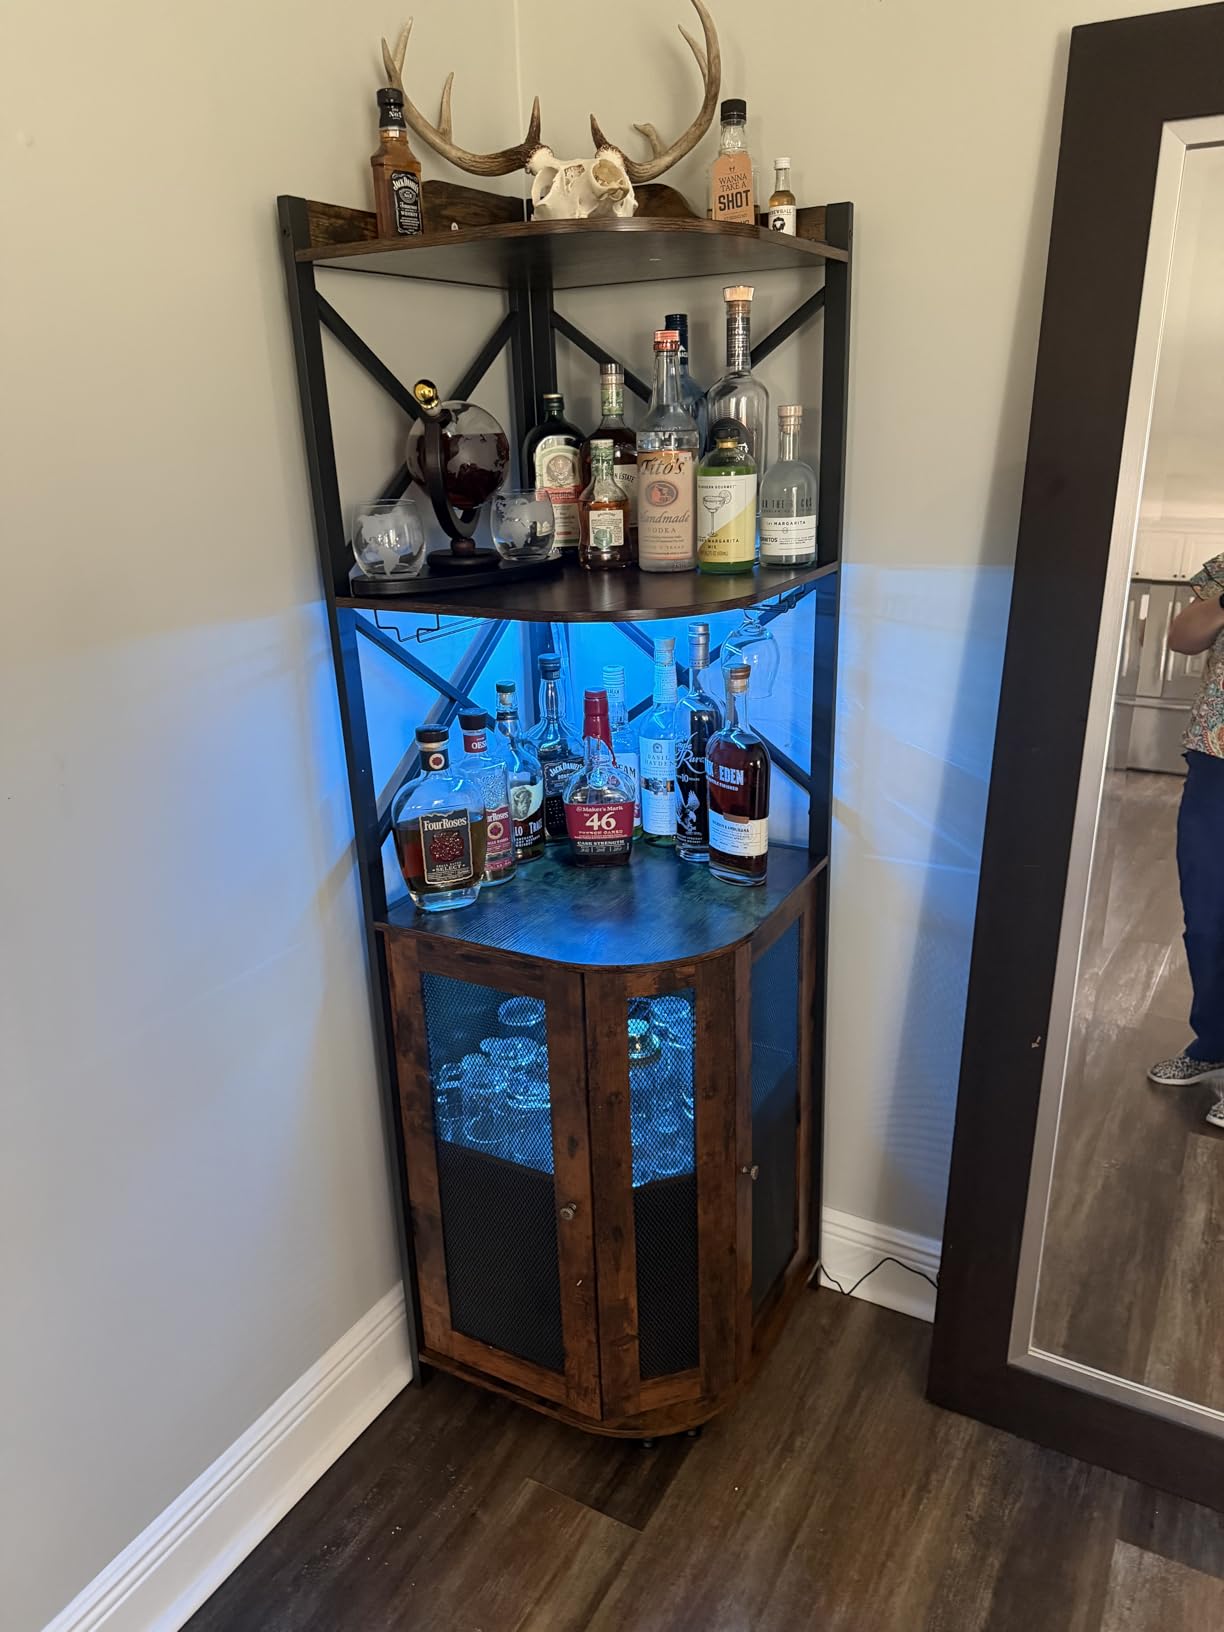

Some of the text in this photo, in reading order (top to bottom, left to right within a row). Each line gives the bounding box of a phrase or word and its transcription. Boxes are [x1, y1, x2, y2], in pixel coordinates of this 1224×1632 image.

[718, 173, 748, 185] WANNA
[720, 182, 740, 193] TAKE
[718, 189, 751, 212] SHOT
[640, 456, 685, 476] Tito's
[549, 764, 563, 778] JACK
[719, 765, 745, 786] EDEN
[585, 811, 616, 831] 46
